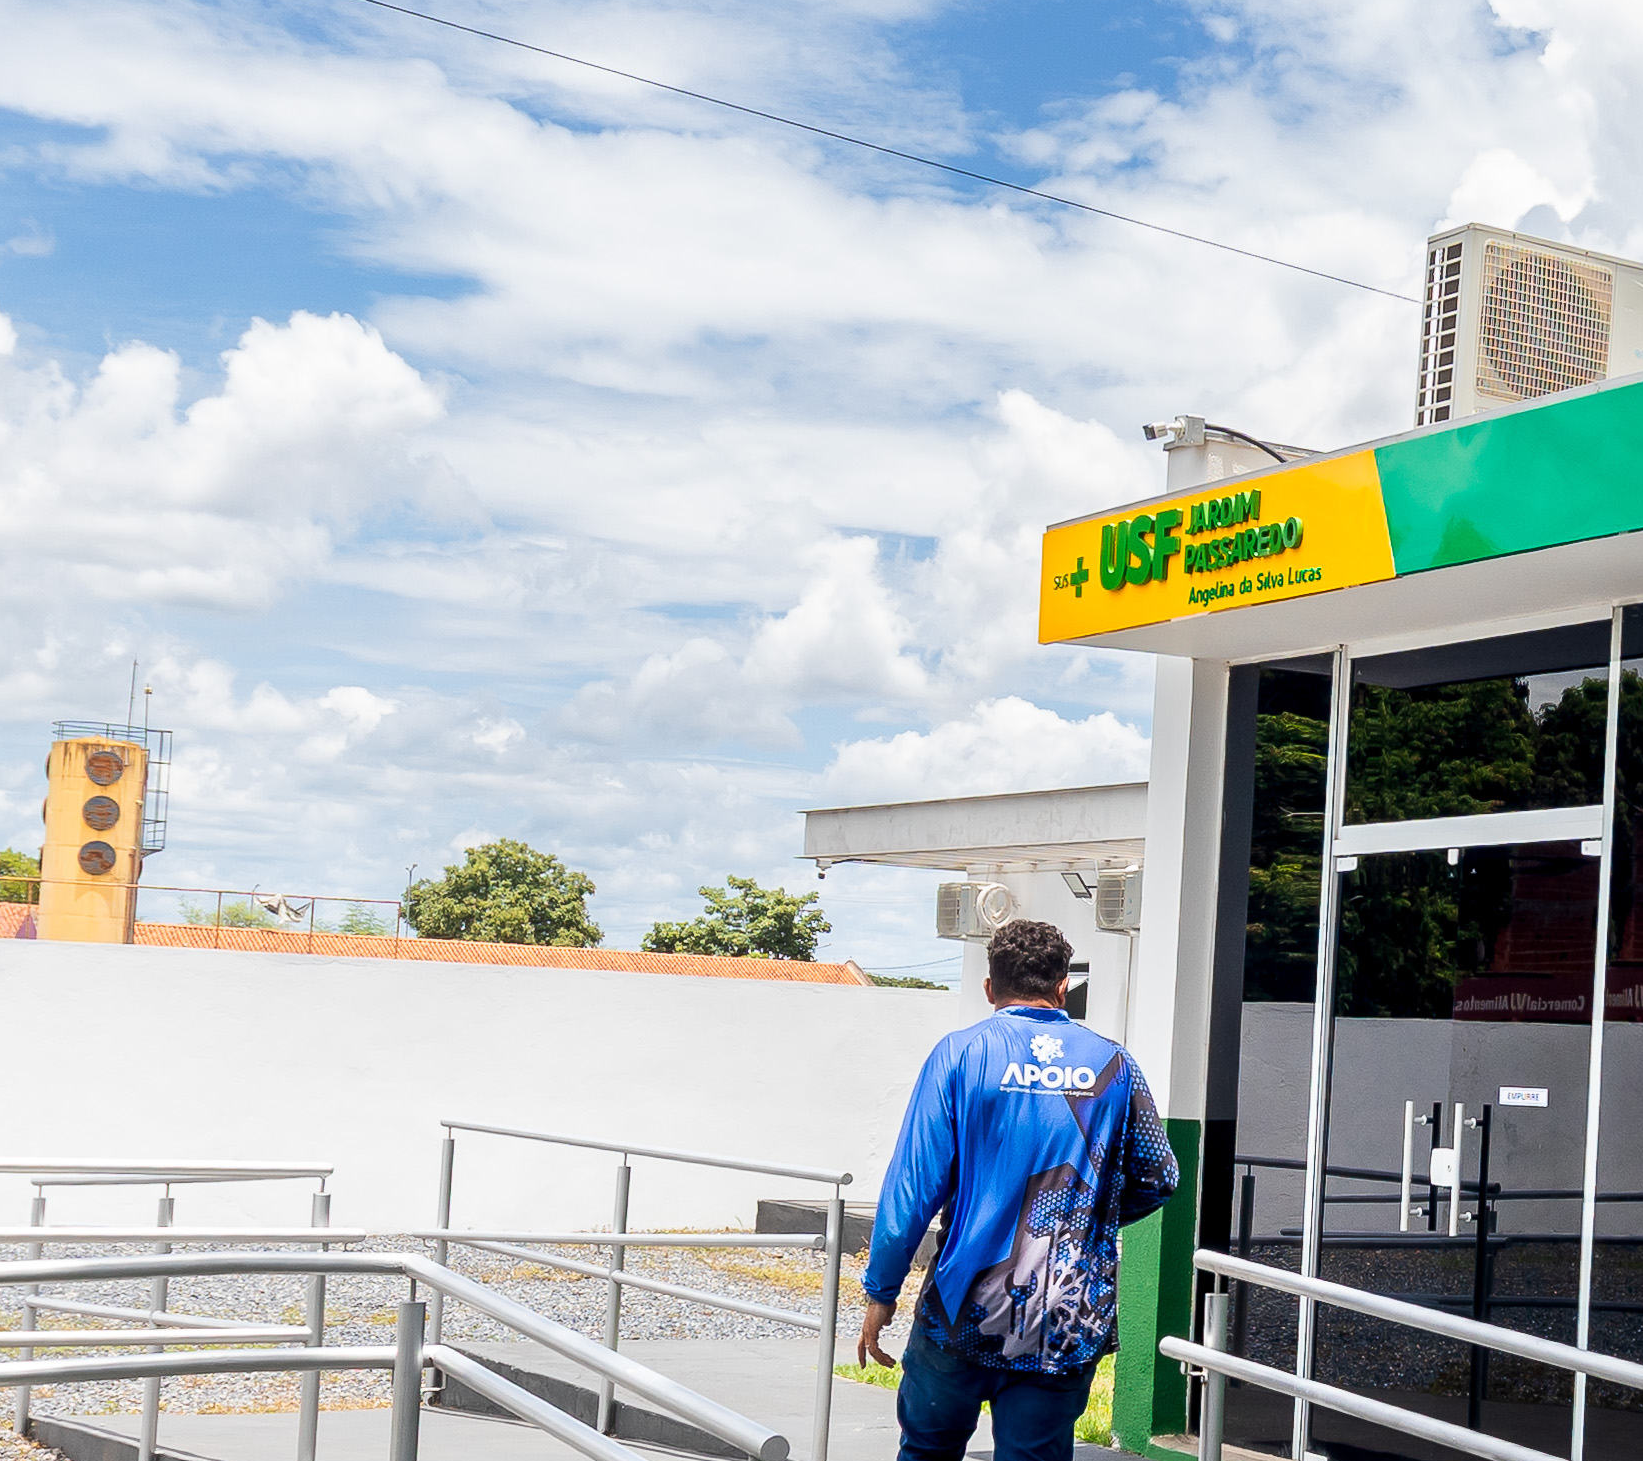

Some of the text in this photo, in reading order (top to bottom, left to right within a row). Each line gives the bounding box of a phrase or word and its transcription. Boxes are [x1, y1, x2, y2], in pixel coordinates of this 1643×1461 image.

[1185, 489, 1261, 535] JARDIM
[1100, 508, 1183, 590] USF
[1184, 517, 1304, 574] PASSAREDO
[1188, 566, 1322, 607] Angelina da Silva Lucas
[1000, 1062, 1096, 1090] APOIO
